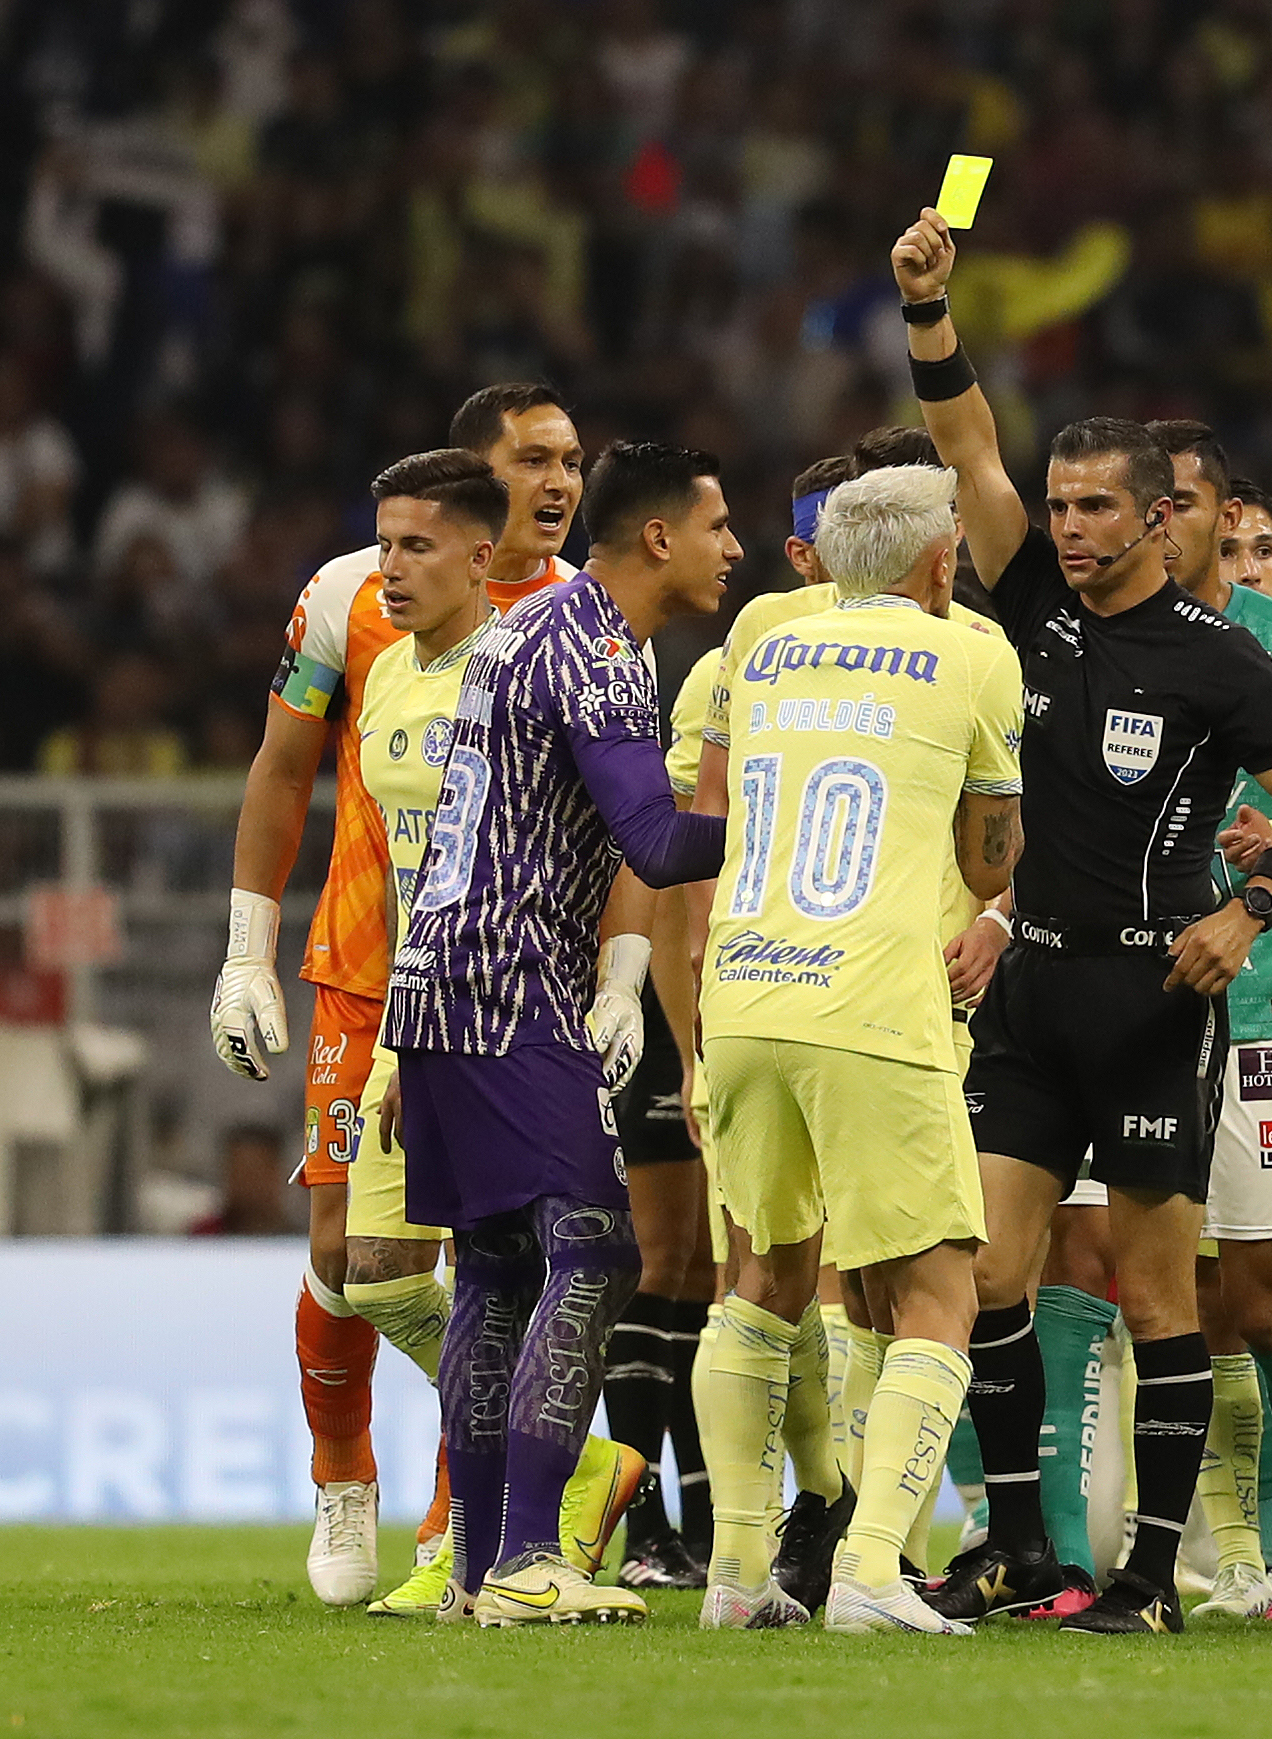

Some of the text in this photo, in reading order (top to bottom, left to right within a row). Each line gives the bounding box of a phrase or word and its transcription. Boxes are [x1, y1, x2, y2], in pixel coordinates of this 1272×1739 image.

[744, 634, 939, 685] Corona
[609, 682, 651, 706] GN
[1023, 687, 1051, 717] MF
[1110, 715, 1155, 738] FIFA
[1107, 743, 1153, 758] REFEREE
[1116, 768, 1139, 779] 2023
[728, 752, 889, 922] 10
[716, 930, 845, 968] Caliente
[717, 964, 833, 988] caliente.mx
[310, 1033, 348, 1065] Red
[311, 1066, 338, 1085] Cola
[1123, 1115, 1178, 1140] FMF
